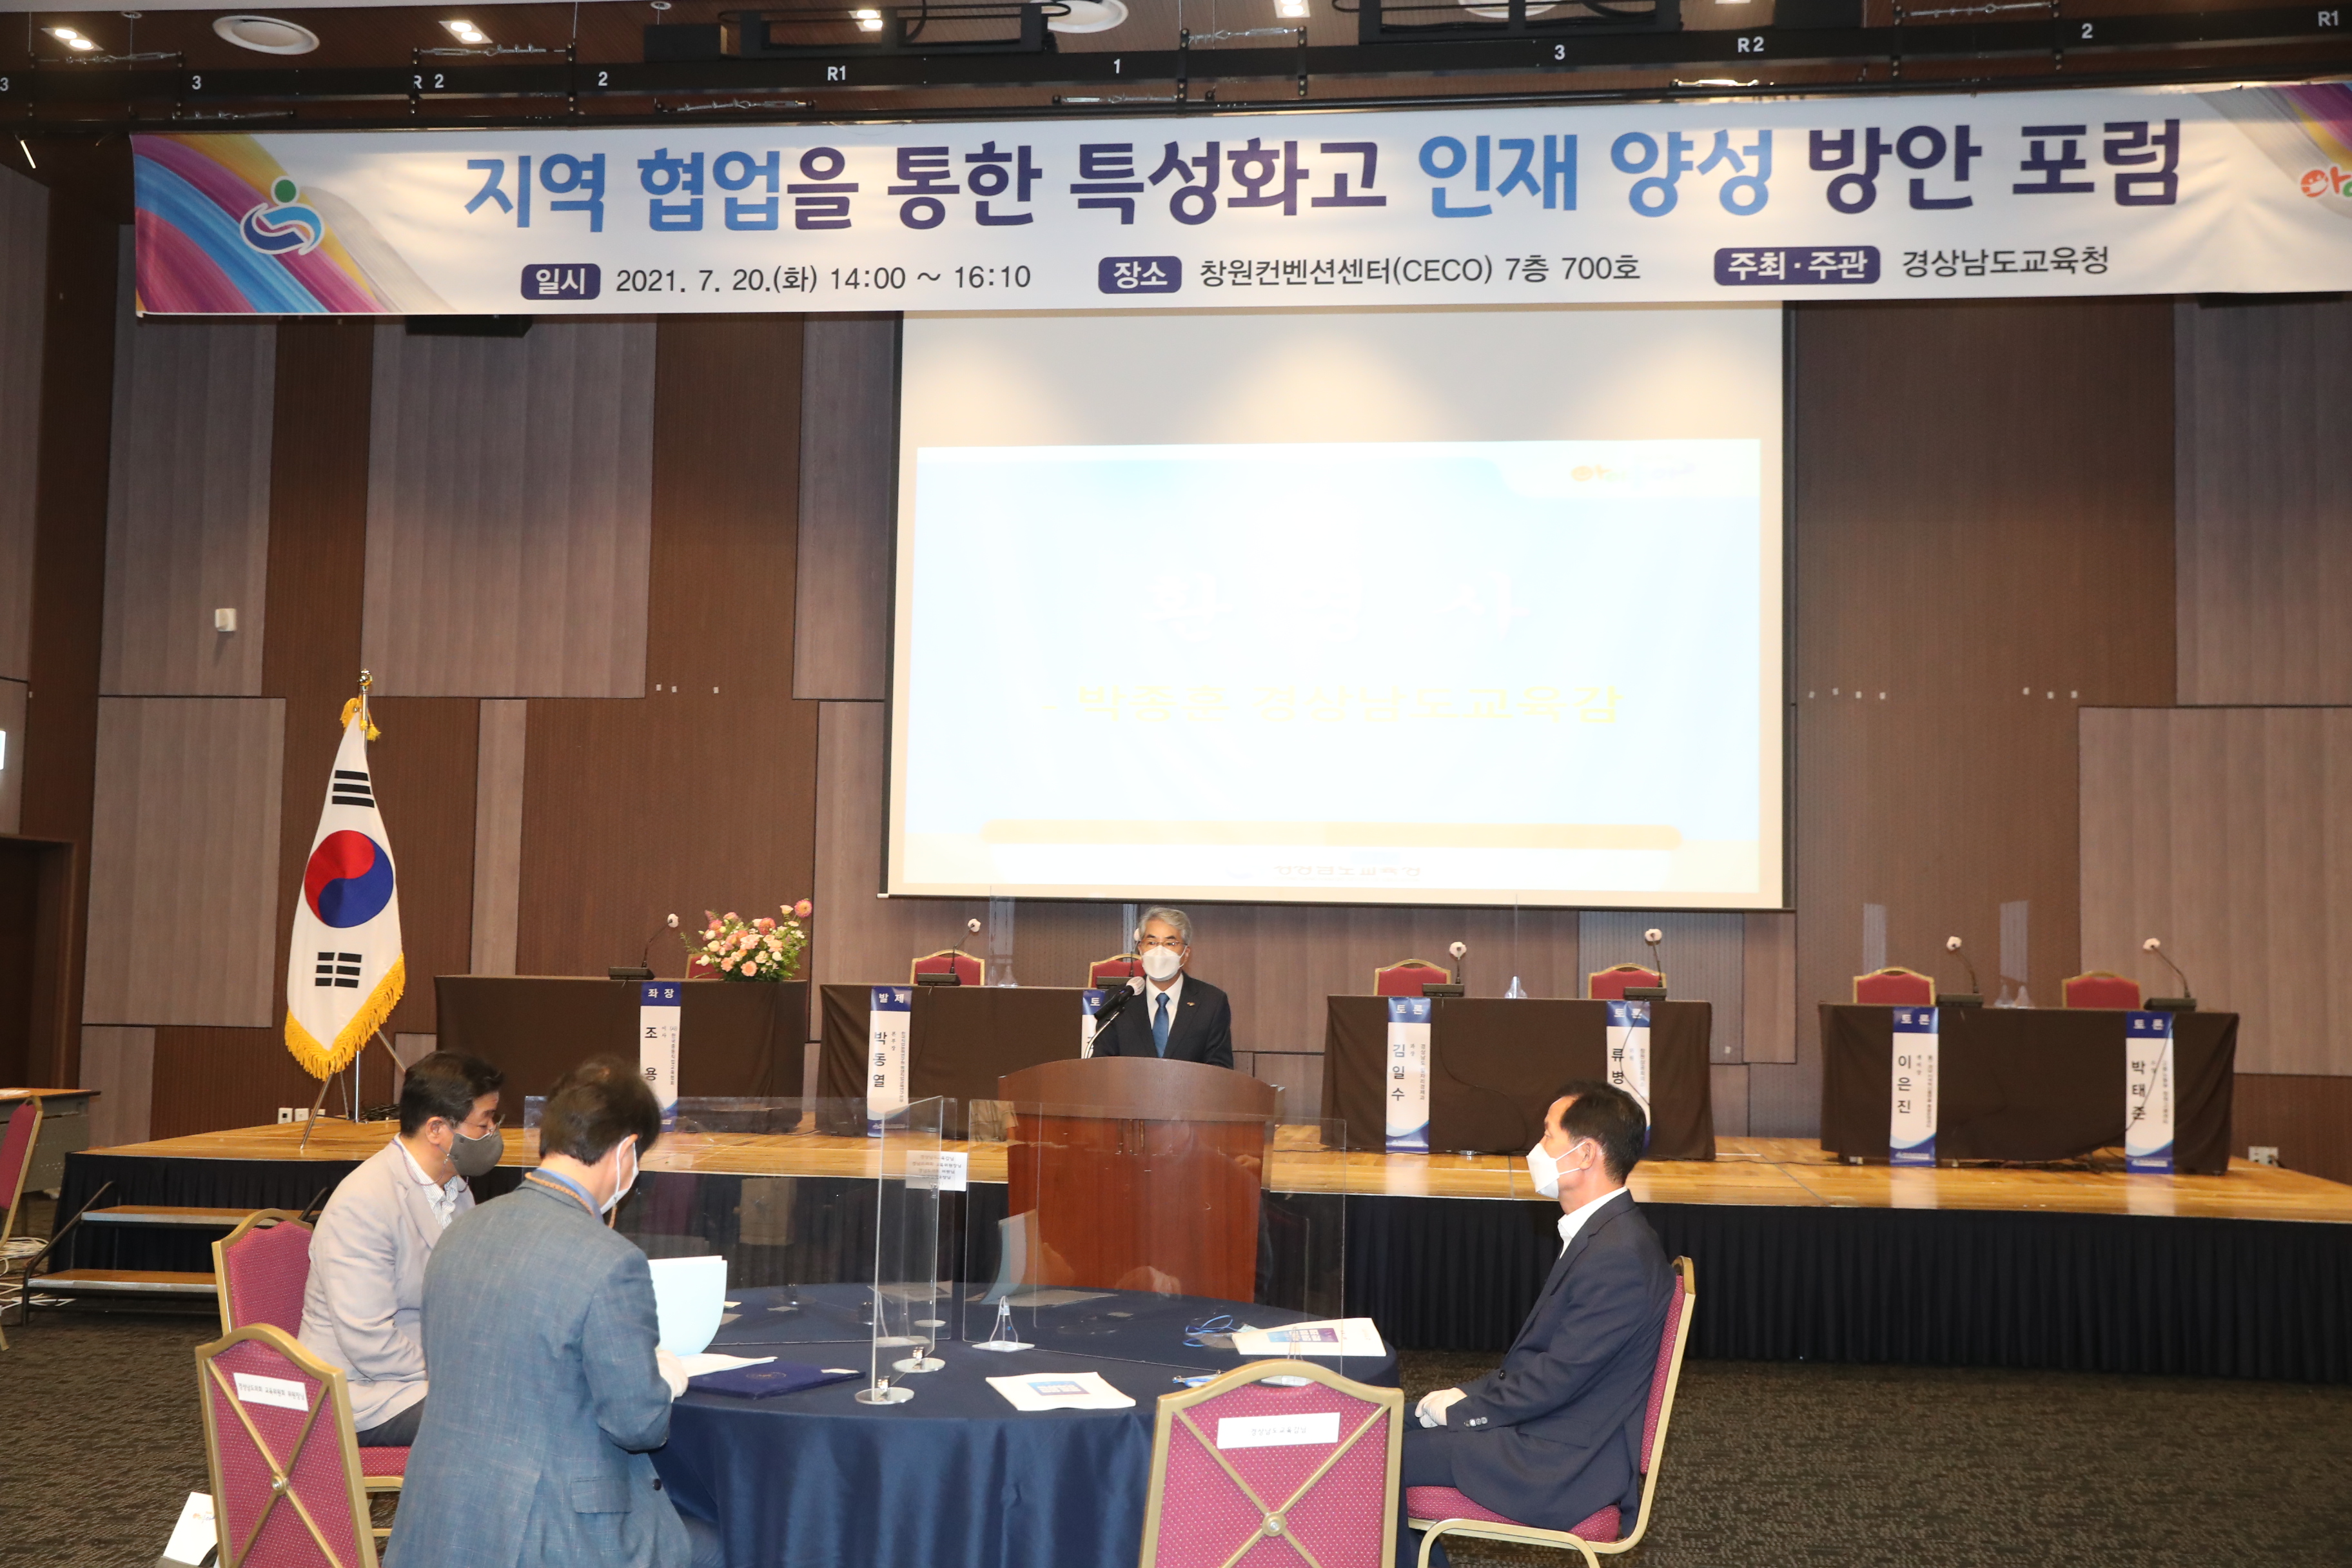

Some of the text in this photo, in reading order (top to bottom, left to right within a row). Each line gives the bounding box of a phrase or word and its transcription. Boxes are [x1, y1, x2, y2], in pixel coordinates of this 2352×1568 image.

[2318, 11, 2338, 26] R1
[2082, 23, 2092, 39] 2
[1555, 44, 1565, 60] 3
[1738, 37, 1763, 52] R2
[828, 66, 845, 81] R1
[1114, 59, 1120, 74] 1
[192, 75, 201, 90] 3
[598, 72, 607, 86] 2
[465, 119, 2180, 232] 지역 협업을 통한 특성화고 인재 양성 방안 포럼
[1904, 247, 2107, 277] 경상남도교육청
[1114, 255, 1640, 288] 장소 창원컨벤션센터(CECO) 7층 700호
[536, 268, 585, 294] 일시
[617, 270, 685, 292] 2021.
[700, 270, 719, 292] 7.
[733, 266, 816, 293] 20.(화)
[832, 268, 905, 289] 14:00
[956, 266, 1030, 288] 16:10
[648, 988, 674, 999] 좌장
[879, 994, 905, 1003] 발제
[1396, 1004, 1424, 1015] 토론
[1901, 1014, 1930, 1024] 토론
[1391, 1044, 1405, 1101] 김일수
[1897, 1055, 1911, 1113] 이은진
